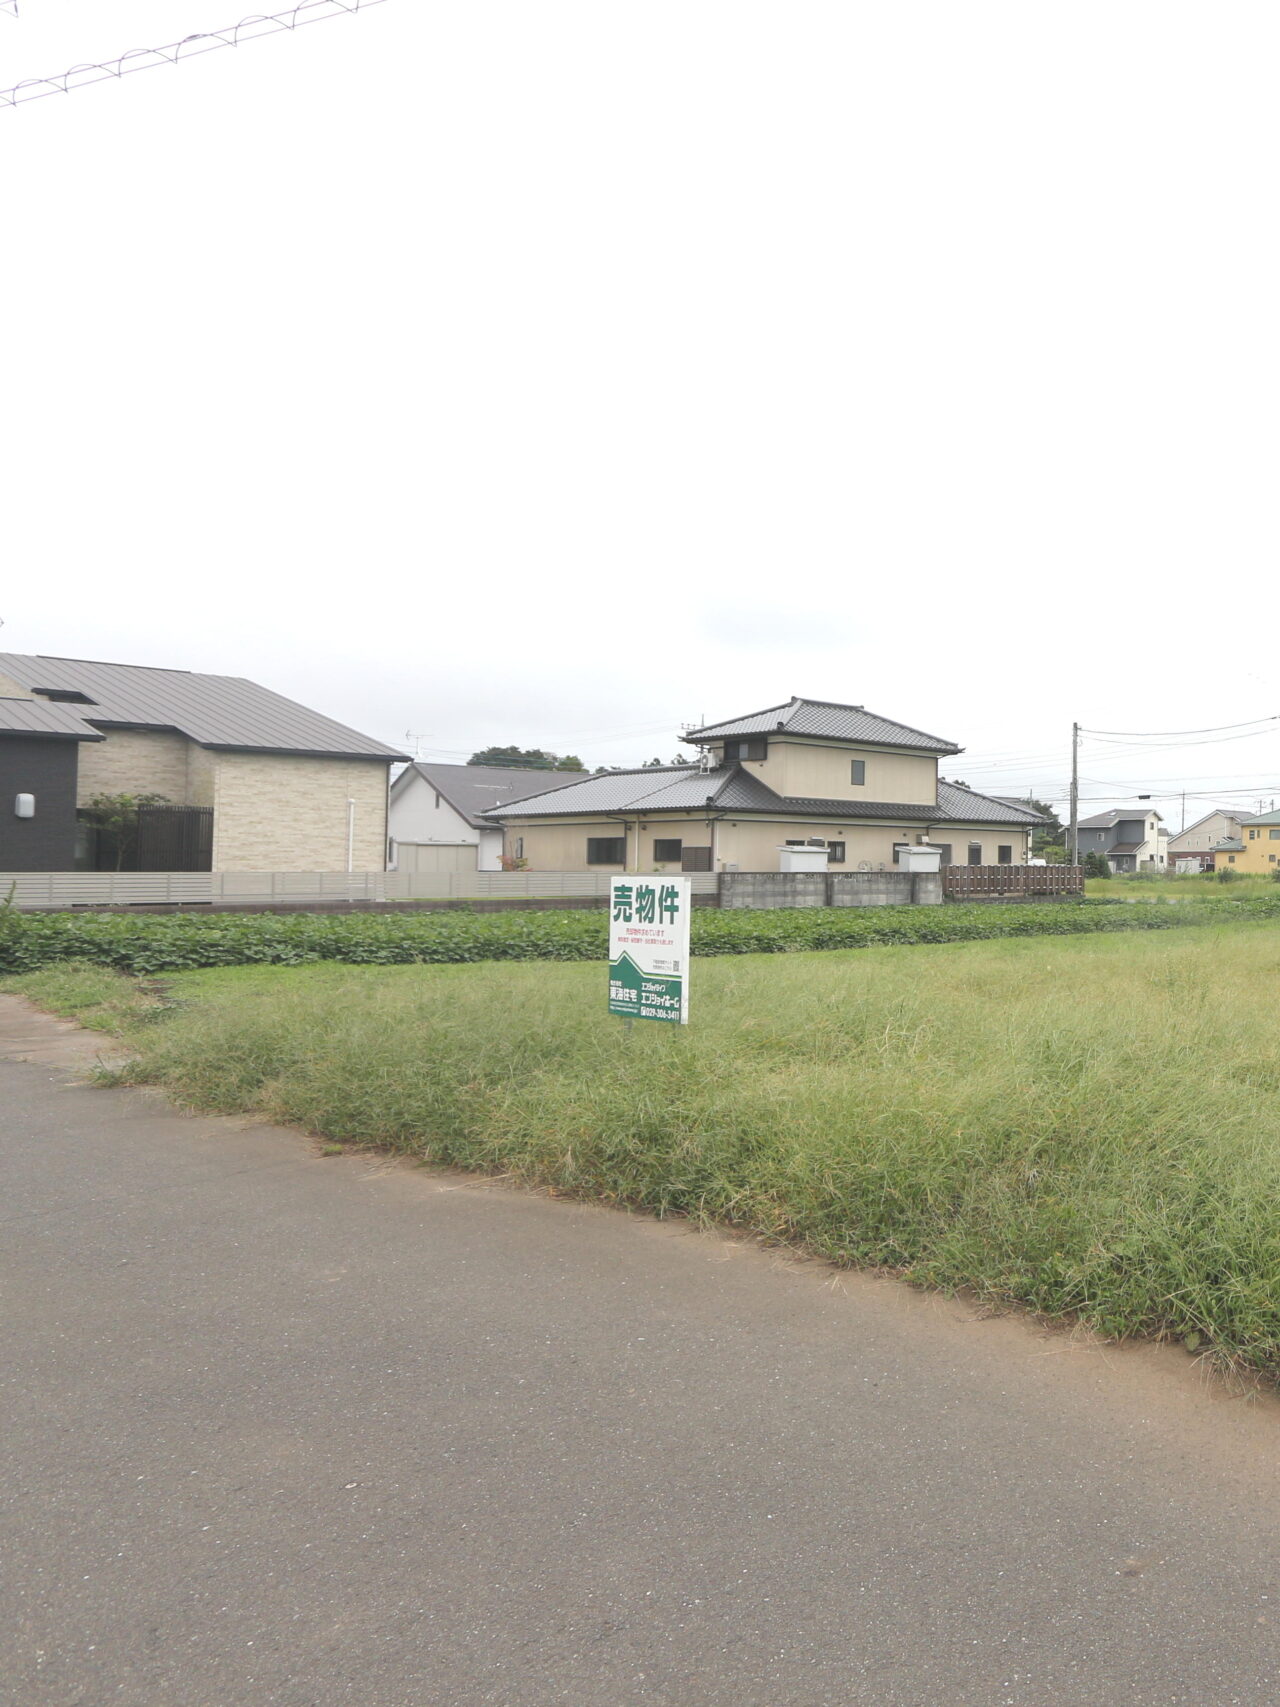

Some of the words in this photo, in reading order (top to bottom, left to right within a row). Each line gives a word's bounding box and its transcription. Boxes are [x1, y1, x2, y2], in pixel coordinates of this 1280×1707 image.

[613, 884, 679, 925] 売物件
[641, 992, 680, 1008] エンジョイホーム
